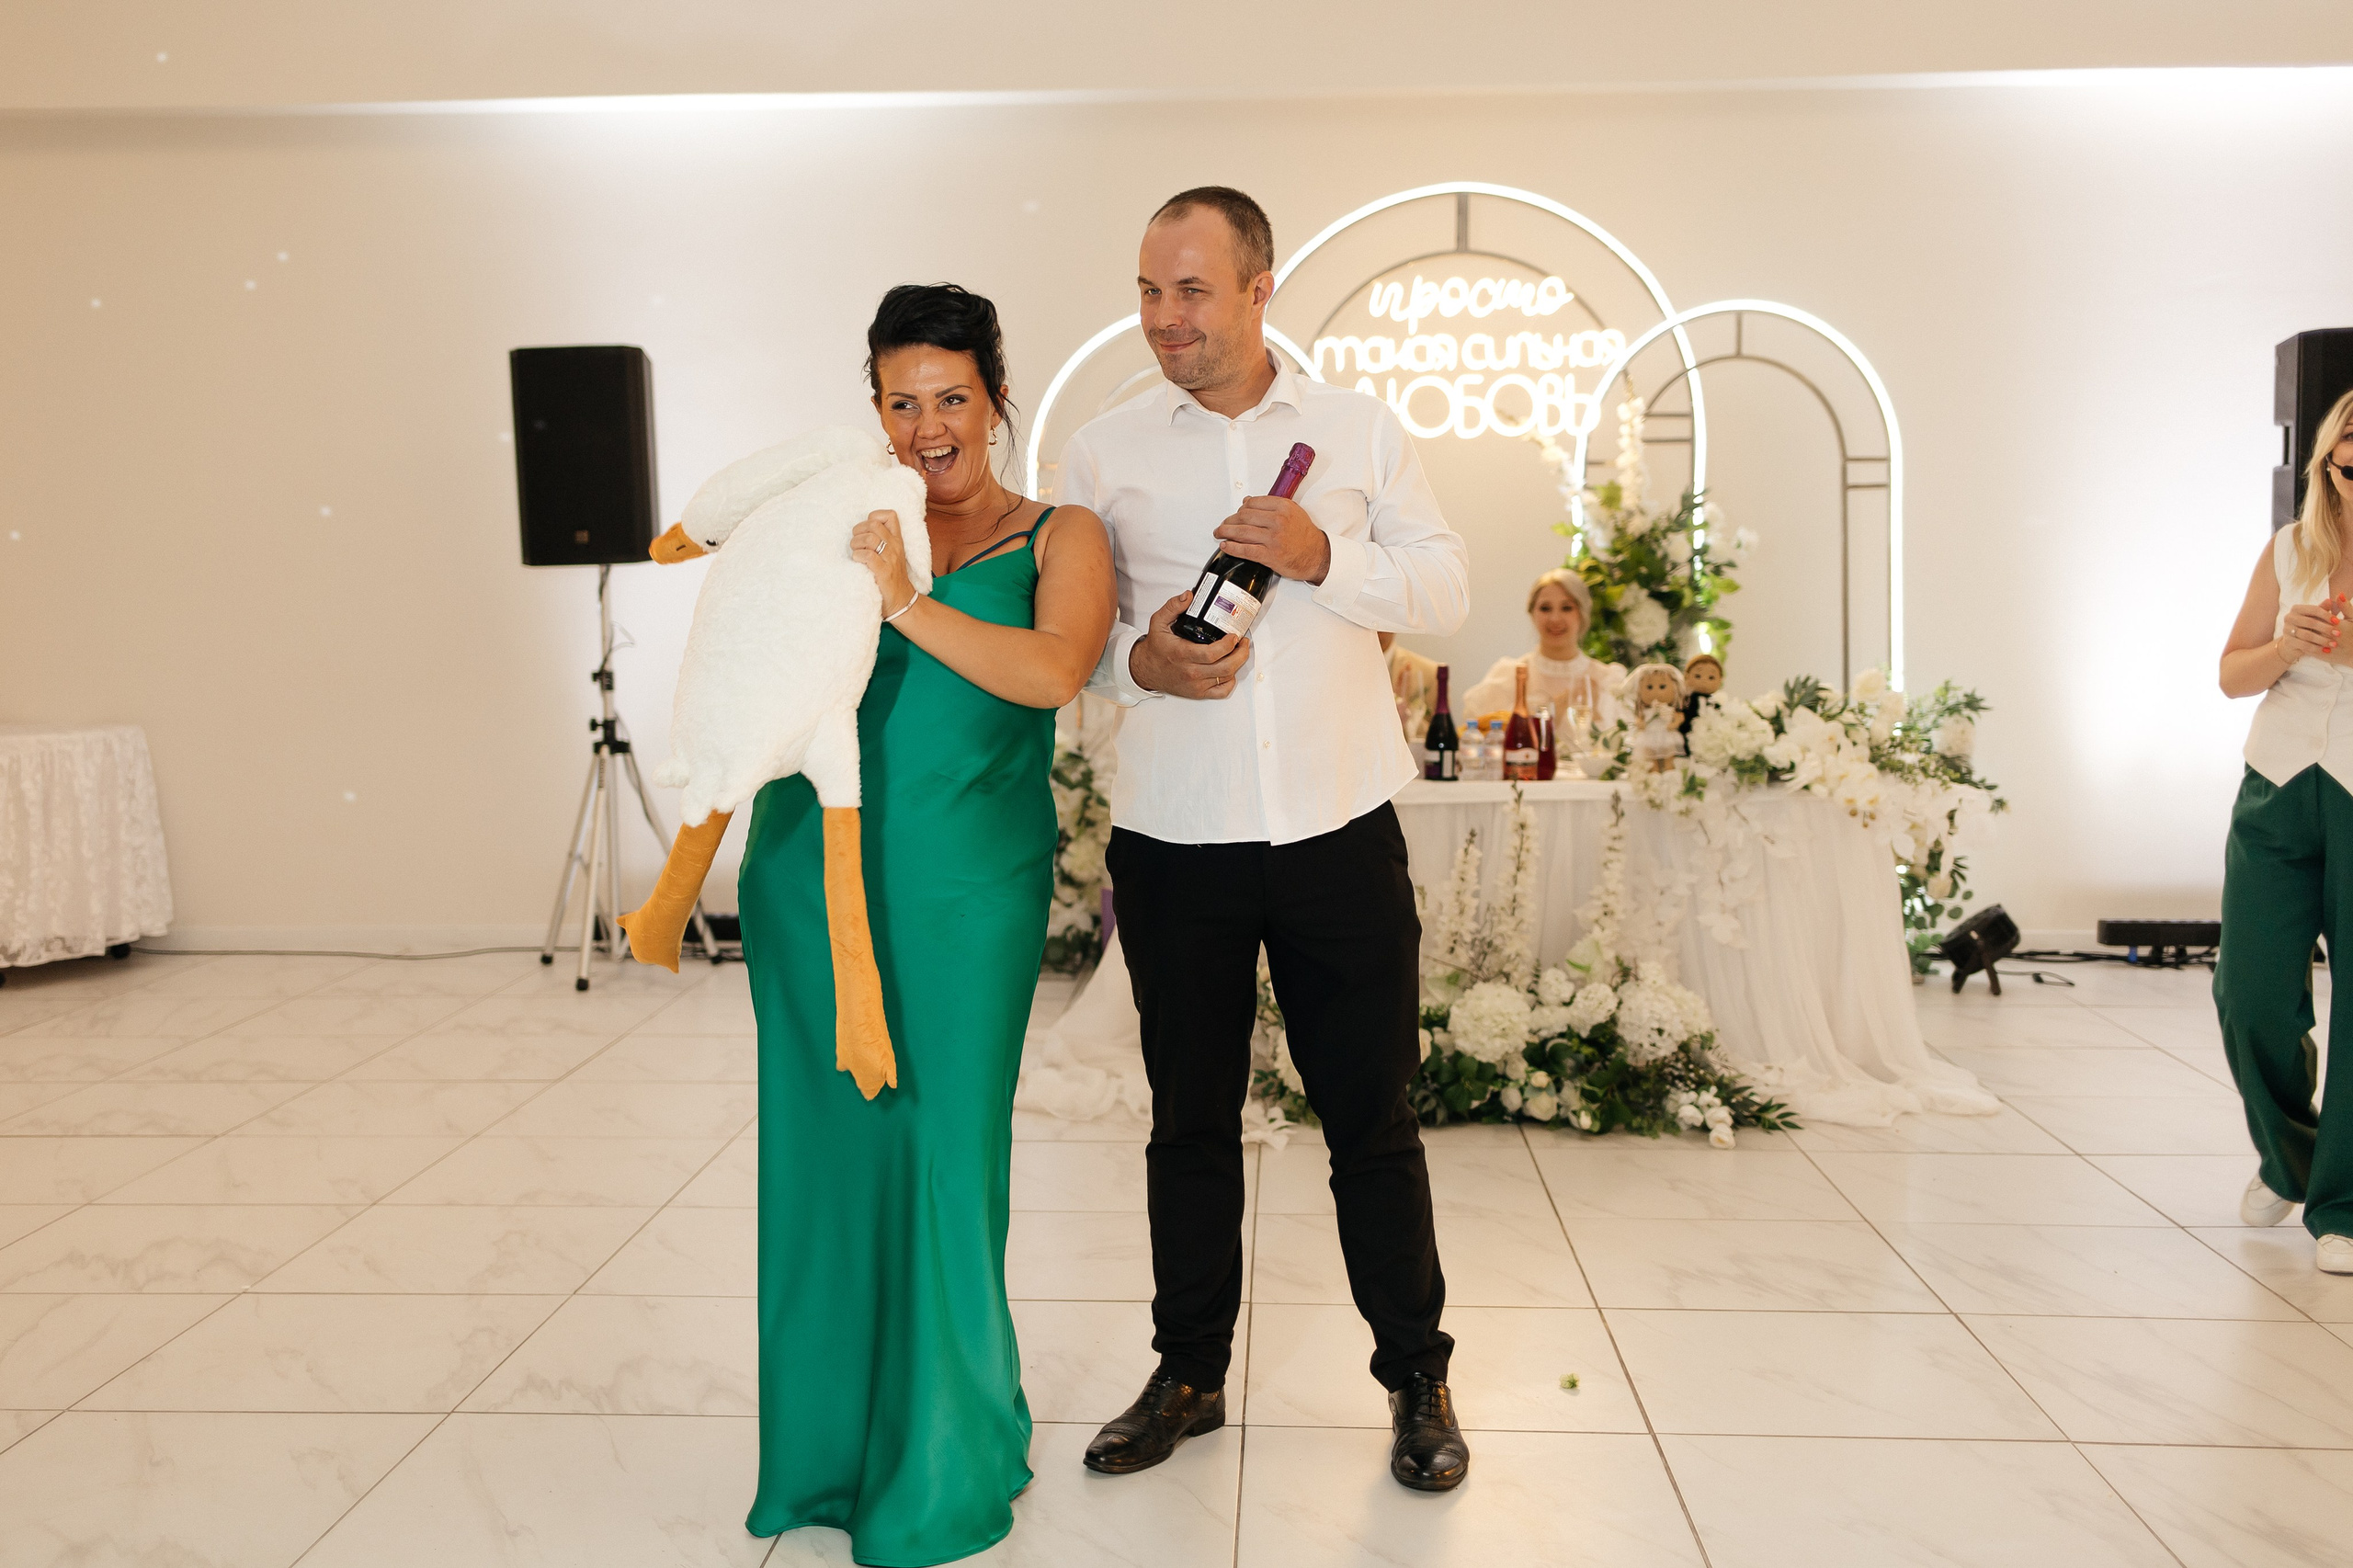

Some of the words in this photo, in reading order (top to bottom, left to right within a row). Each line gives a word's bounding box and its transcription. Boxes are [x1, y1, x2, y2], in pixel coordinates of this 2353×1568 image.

[1370, 276, 1574, 334] просто
[1314, 335, 1457, 372] такая
[1461, 329, 1626, 370] сильная
